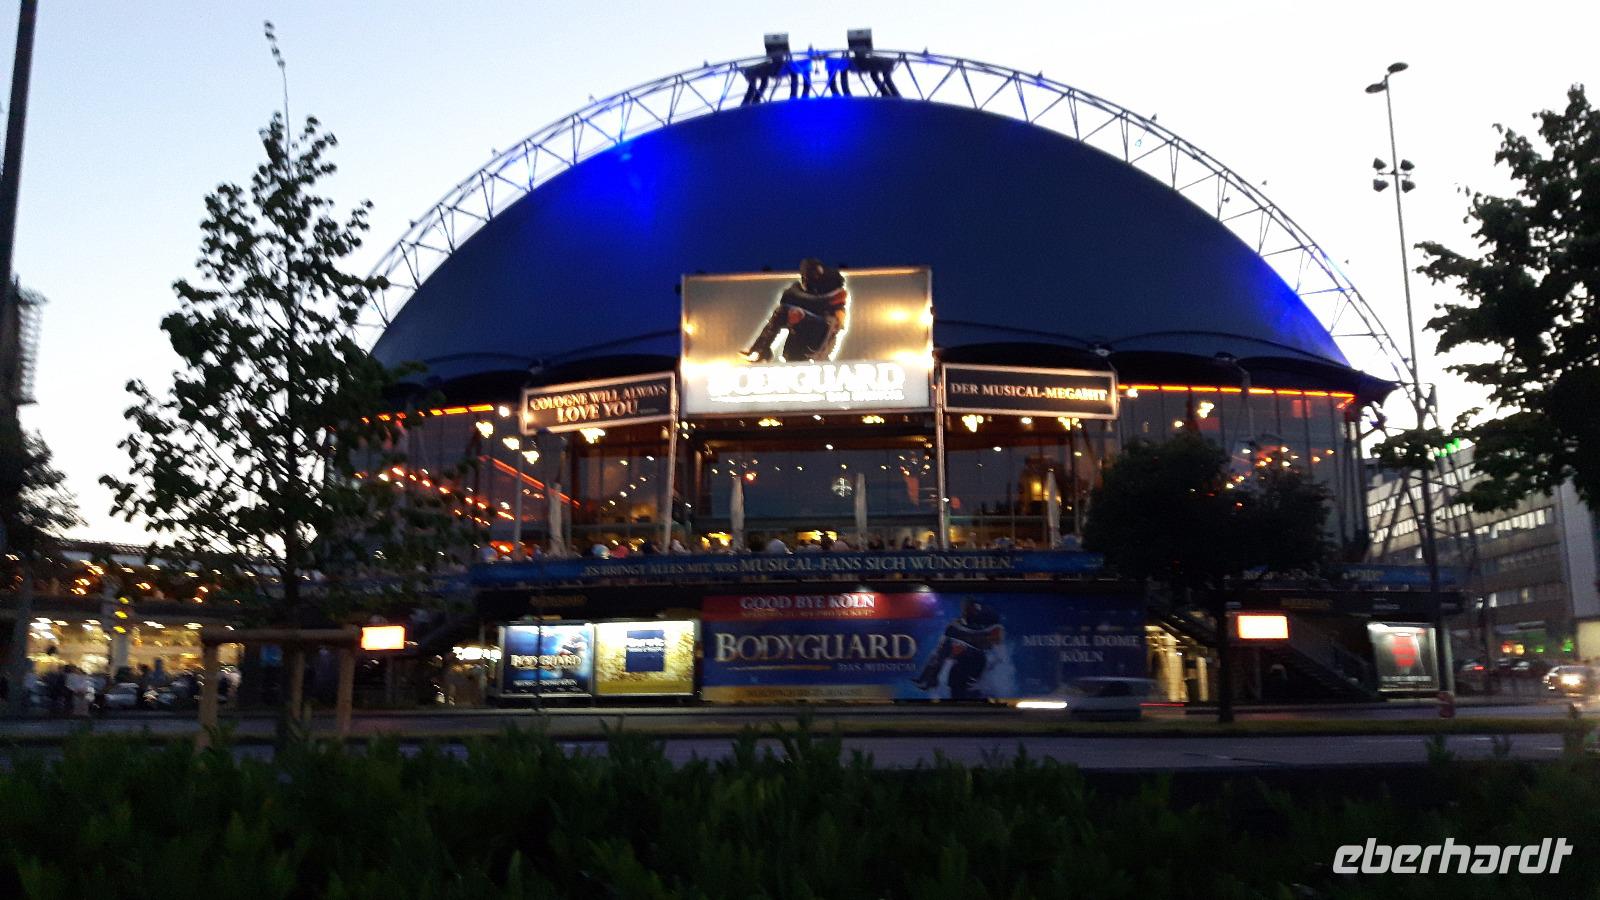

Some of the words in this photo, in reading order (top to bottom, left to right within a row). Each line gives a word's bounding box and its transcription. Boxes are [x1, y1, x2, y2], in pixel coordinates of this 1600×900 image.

[951, 382, 978, 395] DER
[530, 393, 588, 411] COLOGNE
[589, 389, 620, 403] WILL
[624, 385, 667, 400] ALWAYS
[557, 403, 599, 423] LOVE
[602, 400, 638, 417] YOU
[740, 556, 862, 573] MUSICAL-FANS
[866, 556, 905, 571] SICH
[740, 596, 791, 609] GOOD
[796, 595, 824, 609] BYE
[714, 632, 917, 662] BODYGUARD
[1023, 635, 1088, 648] MUSICAL
[1093, 635, 1140, 648] DOME
[510, 654, 582, 668] BODGUARD
[1061, 648, 1103, 663] KÖLN
